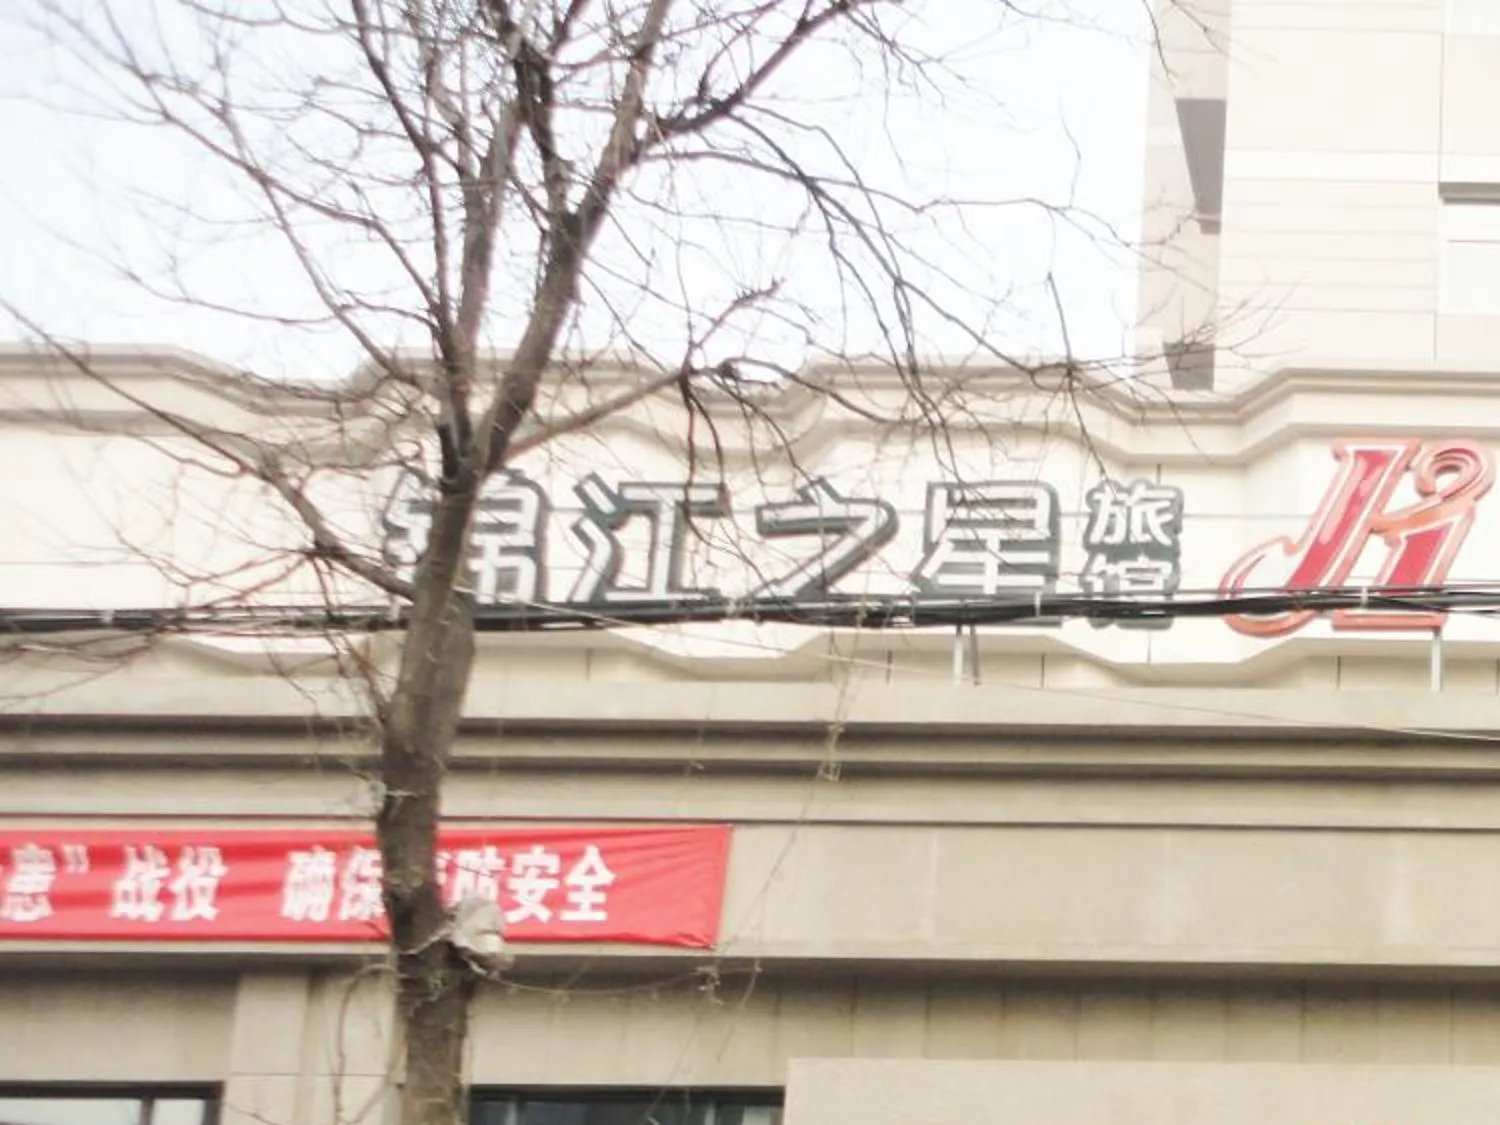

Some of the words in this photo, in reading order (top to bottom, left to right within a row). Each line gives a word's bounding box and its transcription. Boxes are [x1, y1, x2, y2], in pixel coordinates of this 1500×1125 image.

[281, 844, 616, 924] 确保防安全
